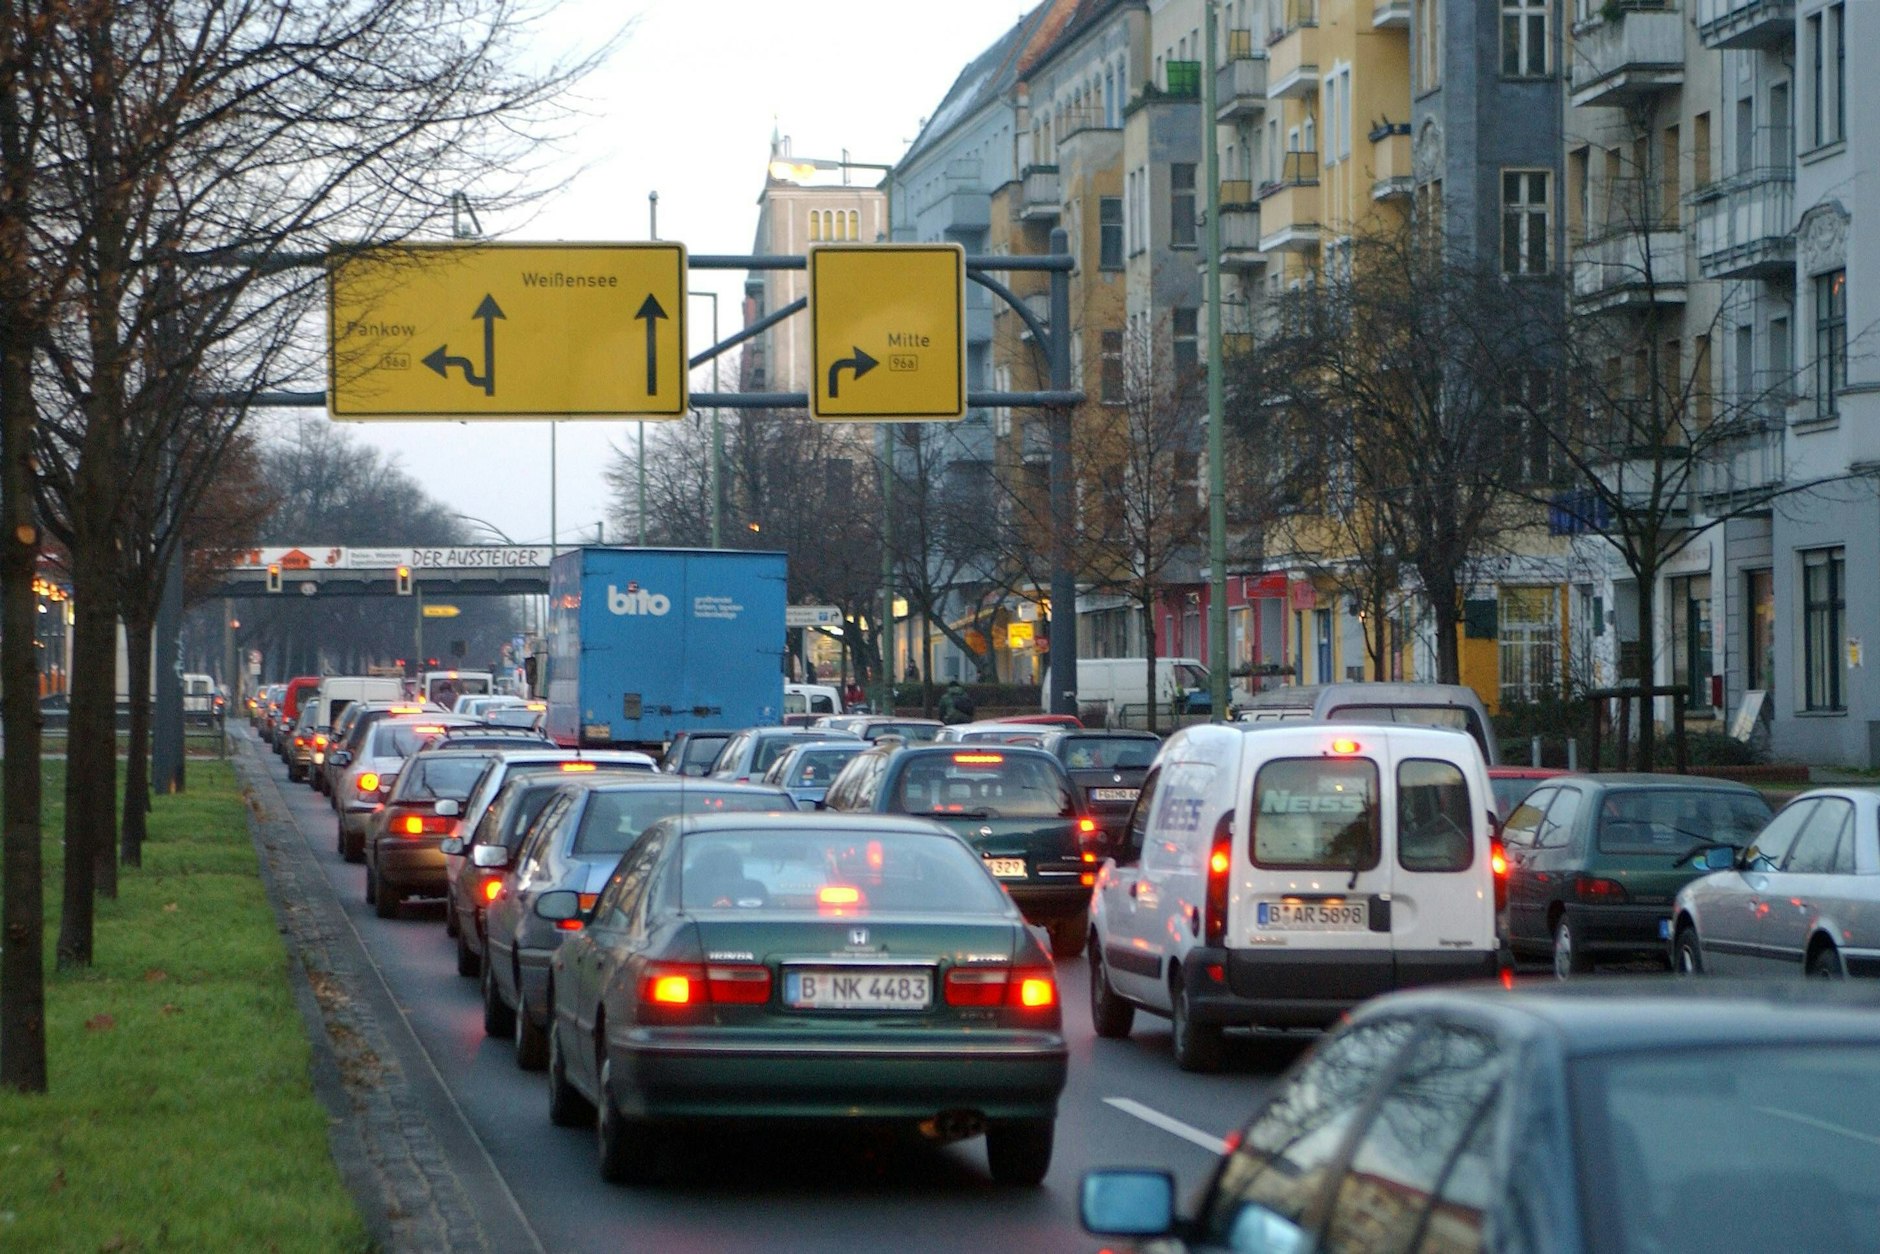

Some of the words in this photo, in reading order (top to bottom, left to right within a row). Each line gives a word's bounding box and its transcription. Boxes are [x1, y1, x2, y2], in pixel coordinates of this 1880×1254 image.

[521, 271, 618, 288] Weißensee
[887, 332, 930, 348] Mitte
[892, 357, 915, 369] 96a
[412, 550, 443, 567] DER
[446, 550, 540, 567] AUSSTEIGER
[607, 581, 671, 616] bito
[1260, 789, 1365, 813] NEISS
[1270, 906, 1281, 923] B
[1292, 906, 1315, 923] AR
[1319, 905, 1363, 924] 5898
[802, 976, 816, 1001] B
[832, 976, 861, 1001] NK
[868, 976, 927, 1001] 4483
